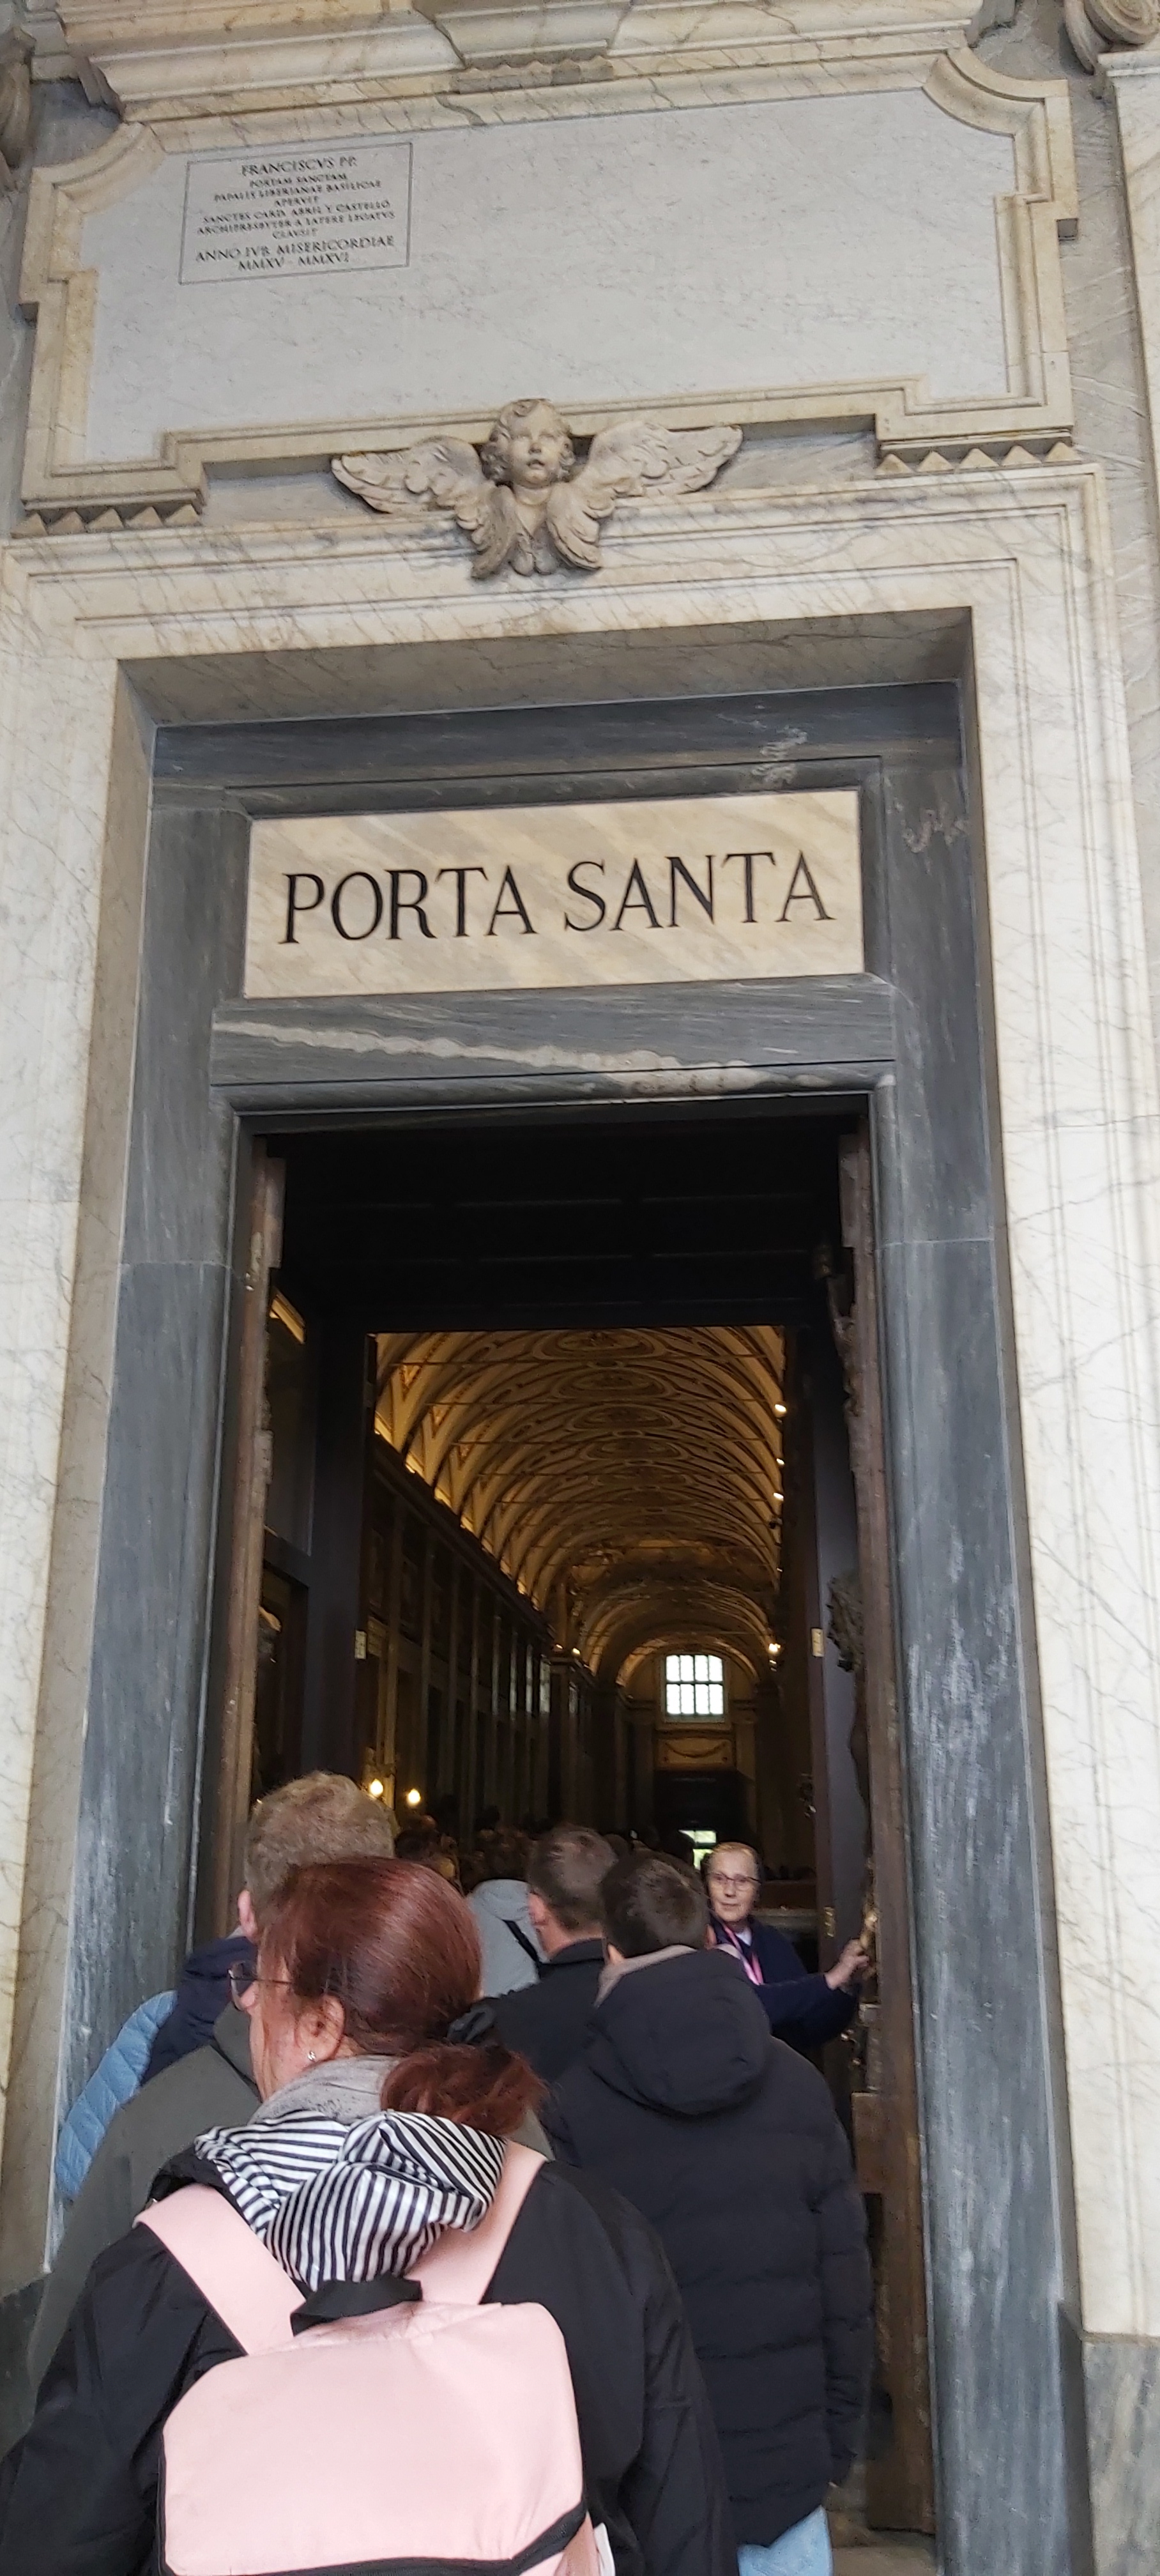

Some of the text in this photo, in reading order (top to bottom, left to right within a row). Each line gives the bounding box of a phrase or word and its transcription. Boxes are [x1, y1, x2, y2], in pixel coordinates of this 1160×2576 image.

[241, 157, 335, 176] FRANCISCVS
[195, 248, 241, 263] ANNO
[277, 235, 394, 254] MISERICORDIAE
[238, 256, 284, 271] MMXV
[298, 252, 349, 266] MMXVI
[279, 851, 836, 944] PORTA SANTA
